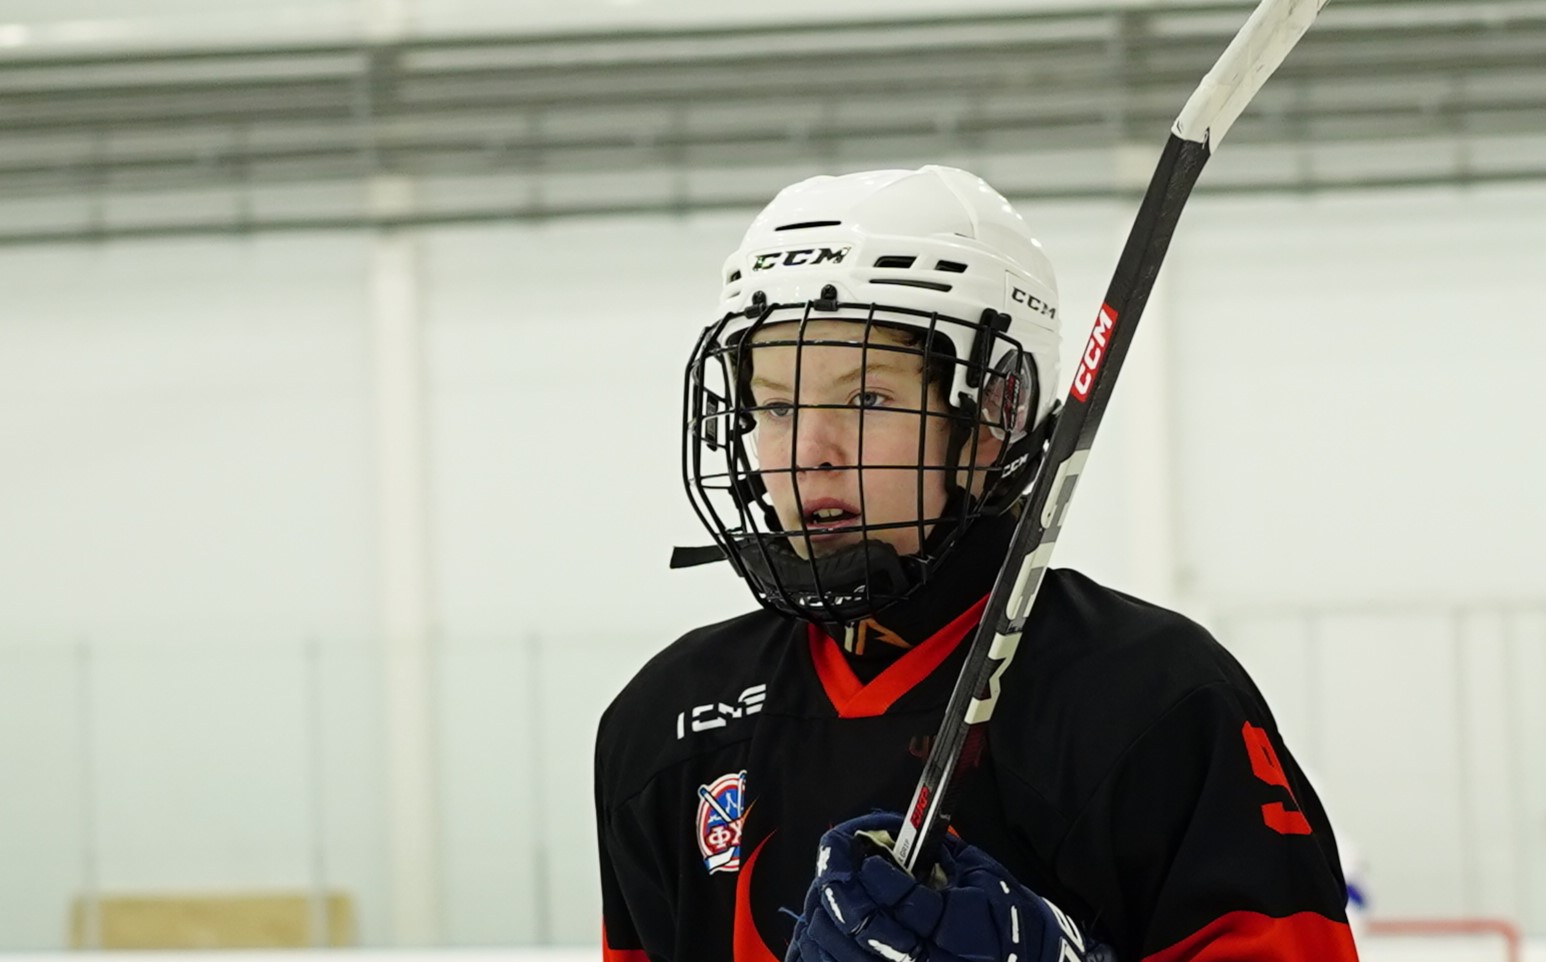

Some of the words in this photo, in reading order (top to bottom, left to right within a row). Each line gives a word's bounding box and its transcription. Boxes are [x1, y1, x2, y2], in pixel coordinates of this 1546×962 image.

[752, 247, 851, 272] CCM
[1011, 286, 1056, 321] CCM
[1074, 308, 1113, 395] CCM
[1242, 720, 1313, 835] 9
